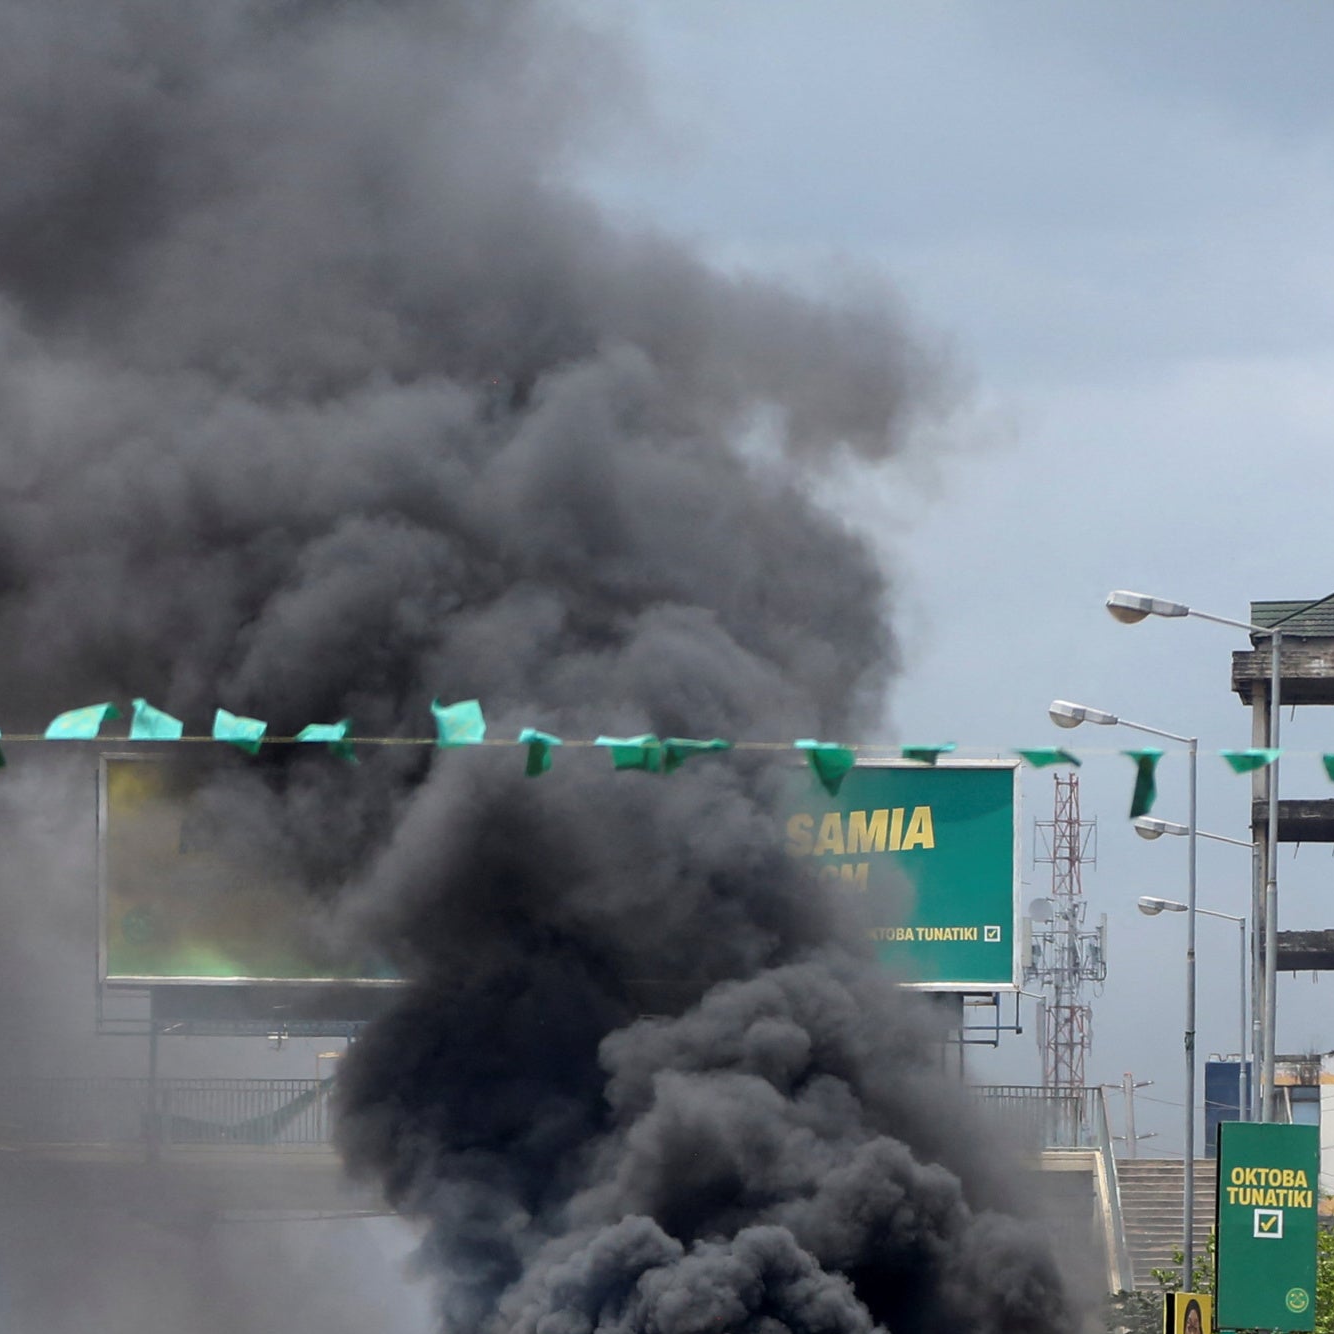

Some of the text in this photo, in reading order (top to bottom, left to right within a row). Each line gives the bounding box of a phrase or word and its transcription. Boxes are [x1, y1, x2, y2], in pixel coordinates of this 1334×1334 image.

[785, 805, 936, 858] SAMIA
[866, 927, 978, 942] KTOBA TUNATIKI
[1230, 1166, 1308, 1189] OKTOBA
[1226, 1186, 1313, 1208] TUNATIKI
